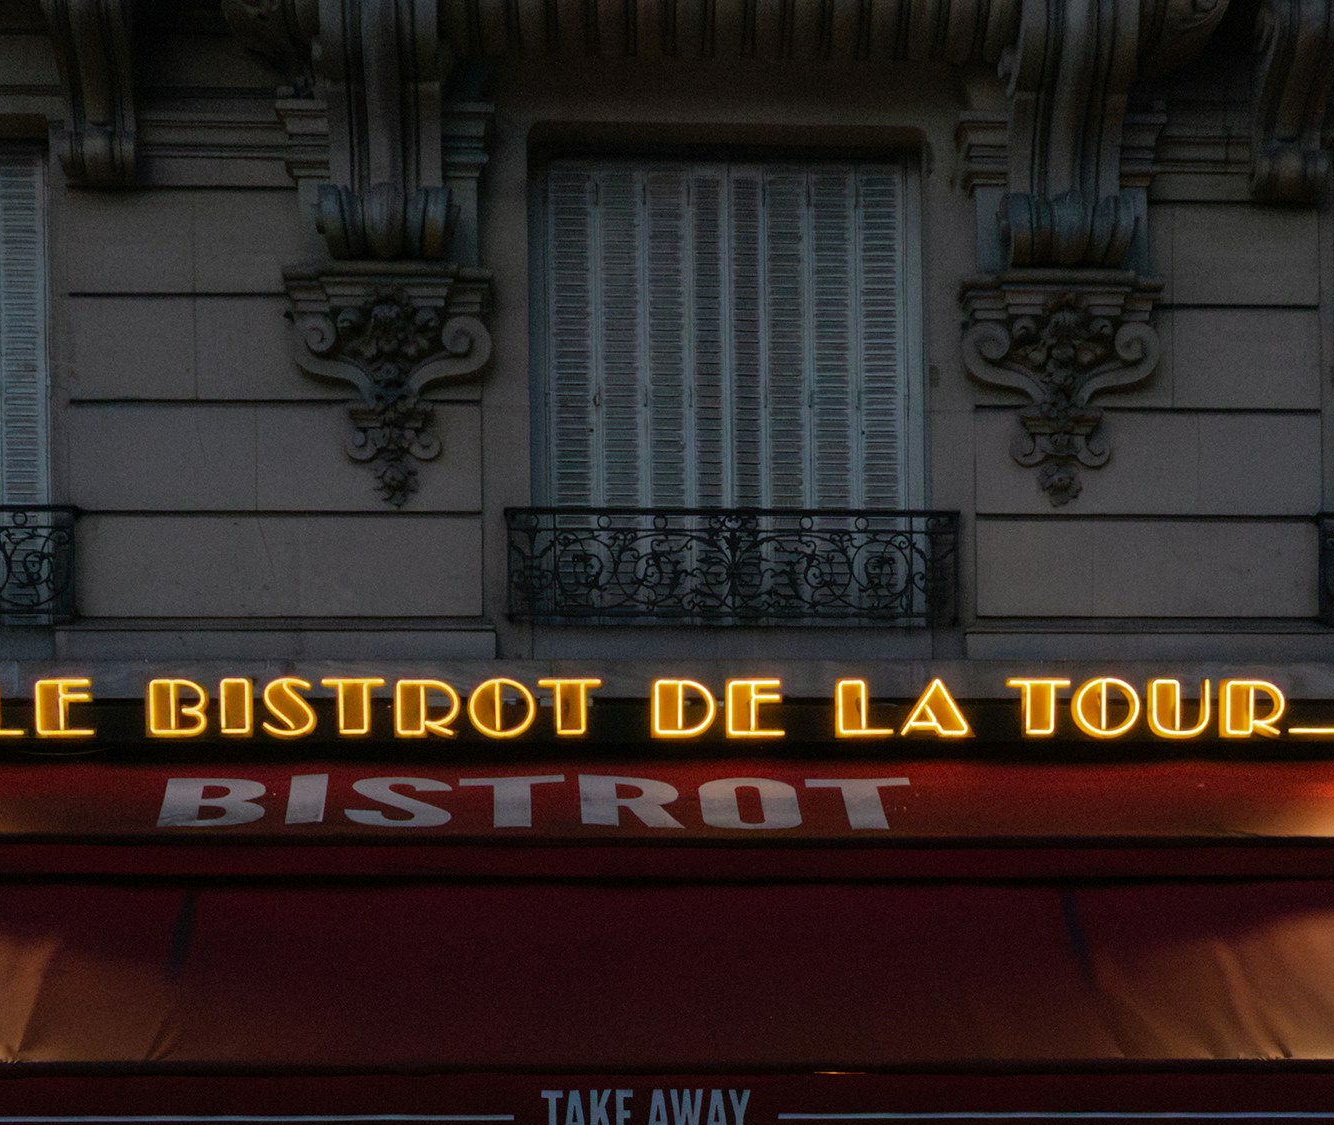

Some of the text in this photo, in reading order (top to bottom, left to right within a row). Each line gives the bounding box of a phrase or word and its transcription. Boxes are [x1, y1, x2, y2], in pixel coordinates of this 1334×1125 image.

[147, 676, 603, 738] BISTROT
[651, 678, 786, 738] DE
[834, 678, 975, 738] LA
[1004, 677, 1288, 738] TOUR
[156, 773, 910, 831] BISTROT
